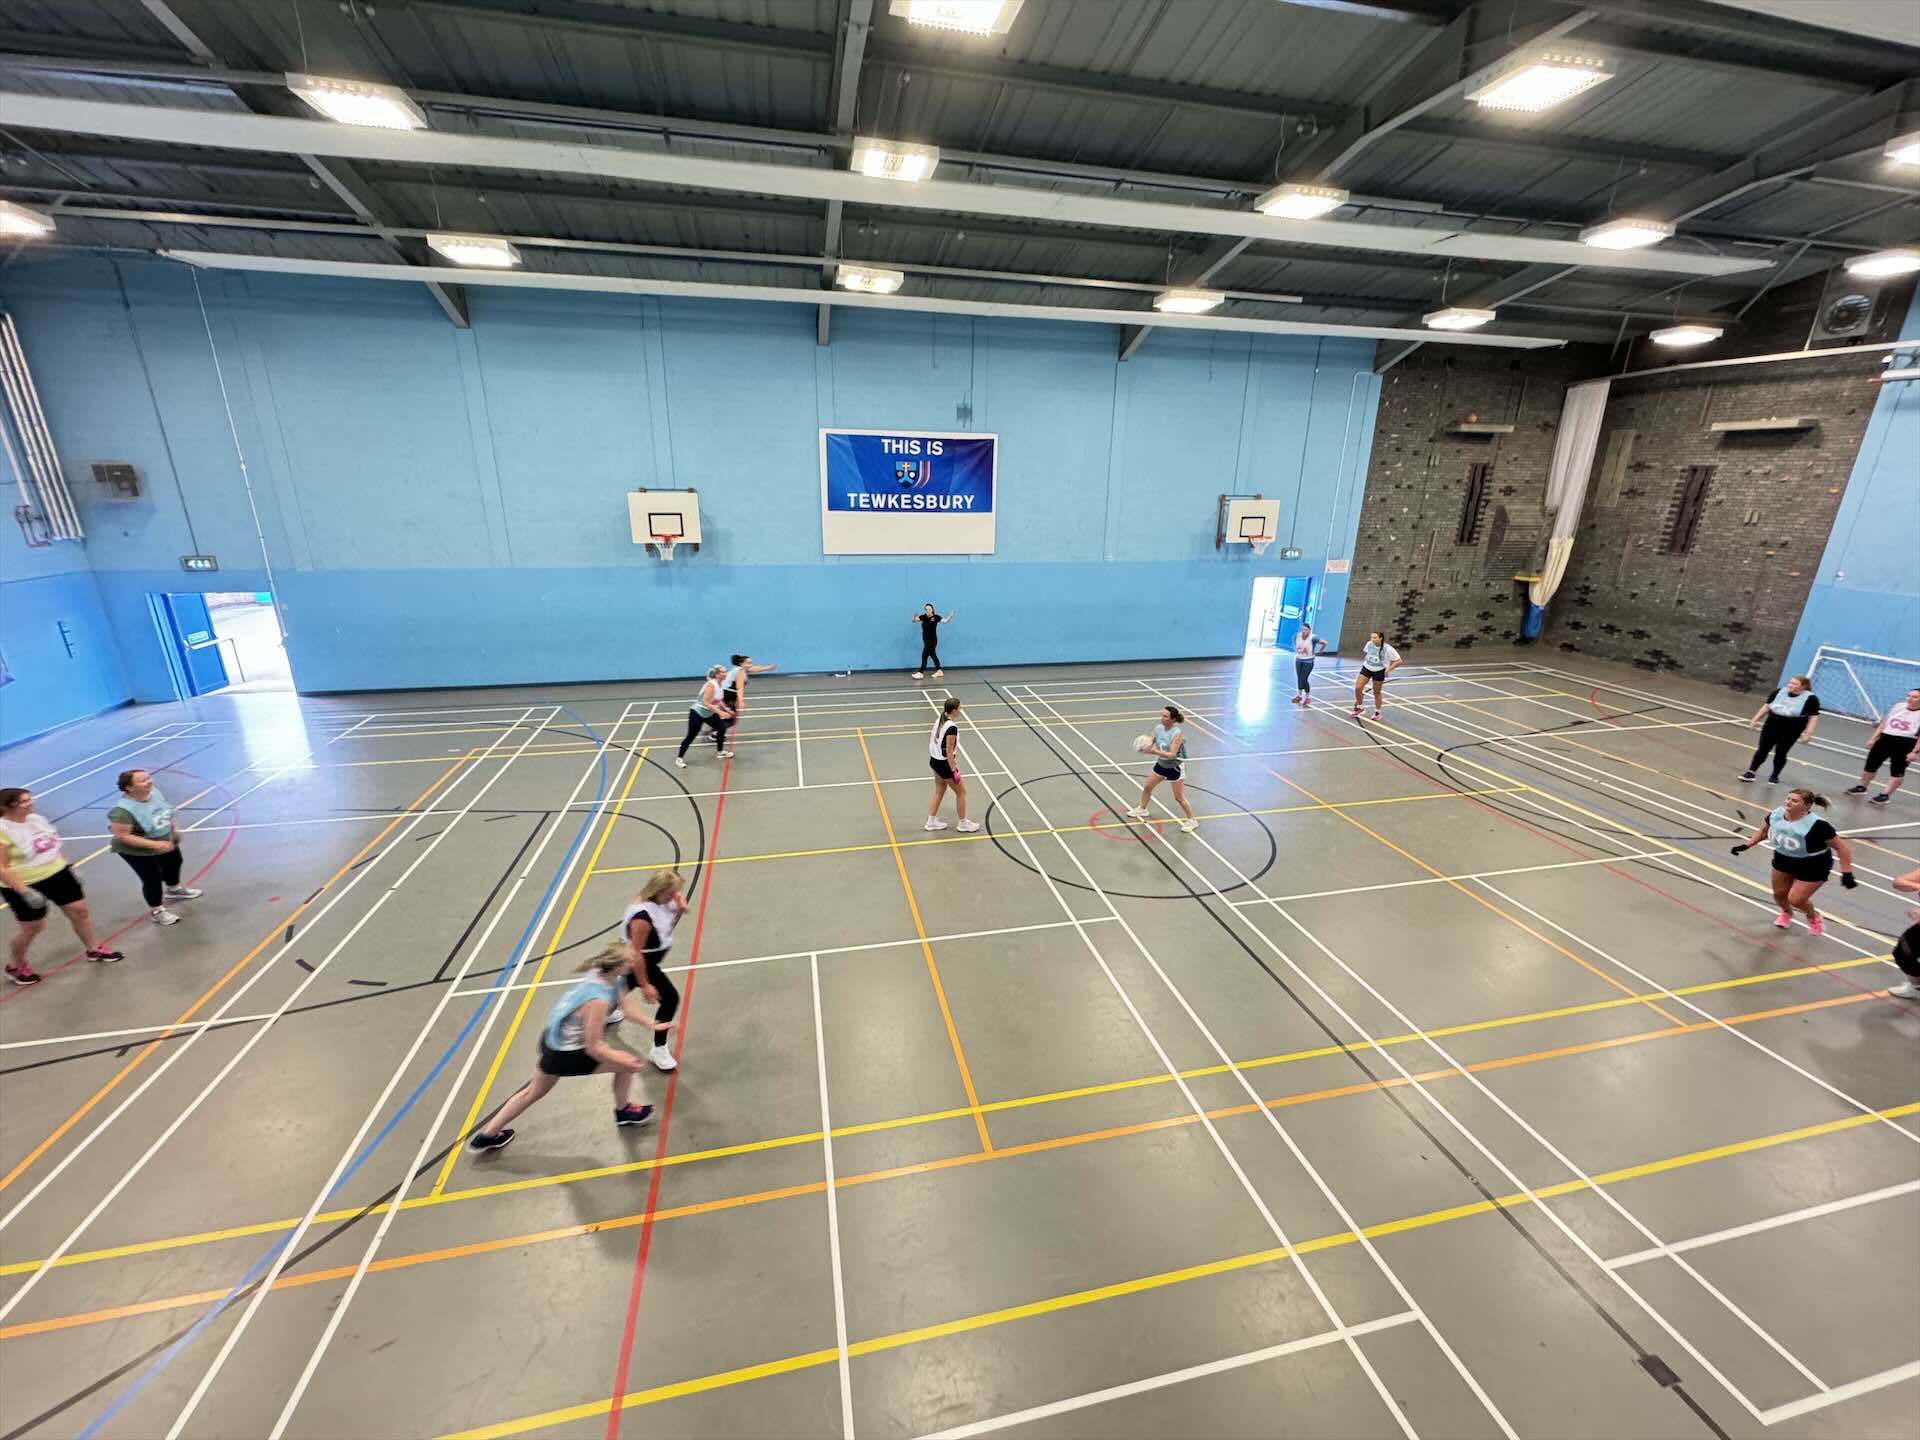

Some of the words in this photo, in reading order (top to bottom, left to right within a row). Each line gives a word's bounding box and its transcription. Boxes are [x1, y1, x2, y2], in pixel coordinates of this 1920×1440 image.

[881, 439, 921, 455] THIS
[927, 441, 943, 456] IS
[847, 493, 975, 509] TEWKESBURY
[1889, 718, 1910, 731] GS
